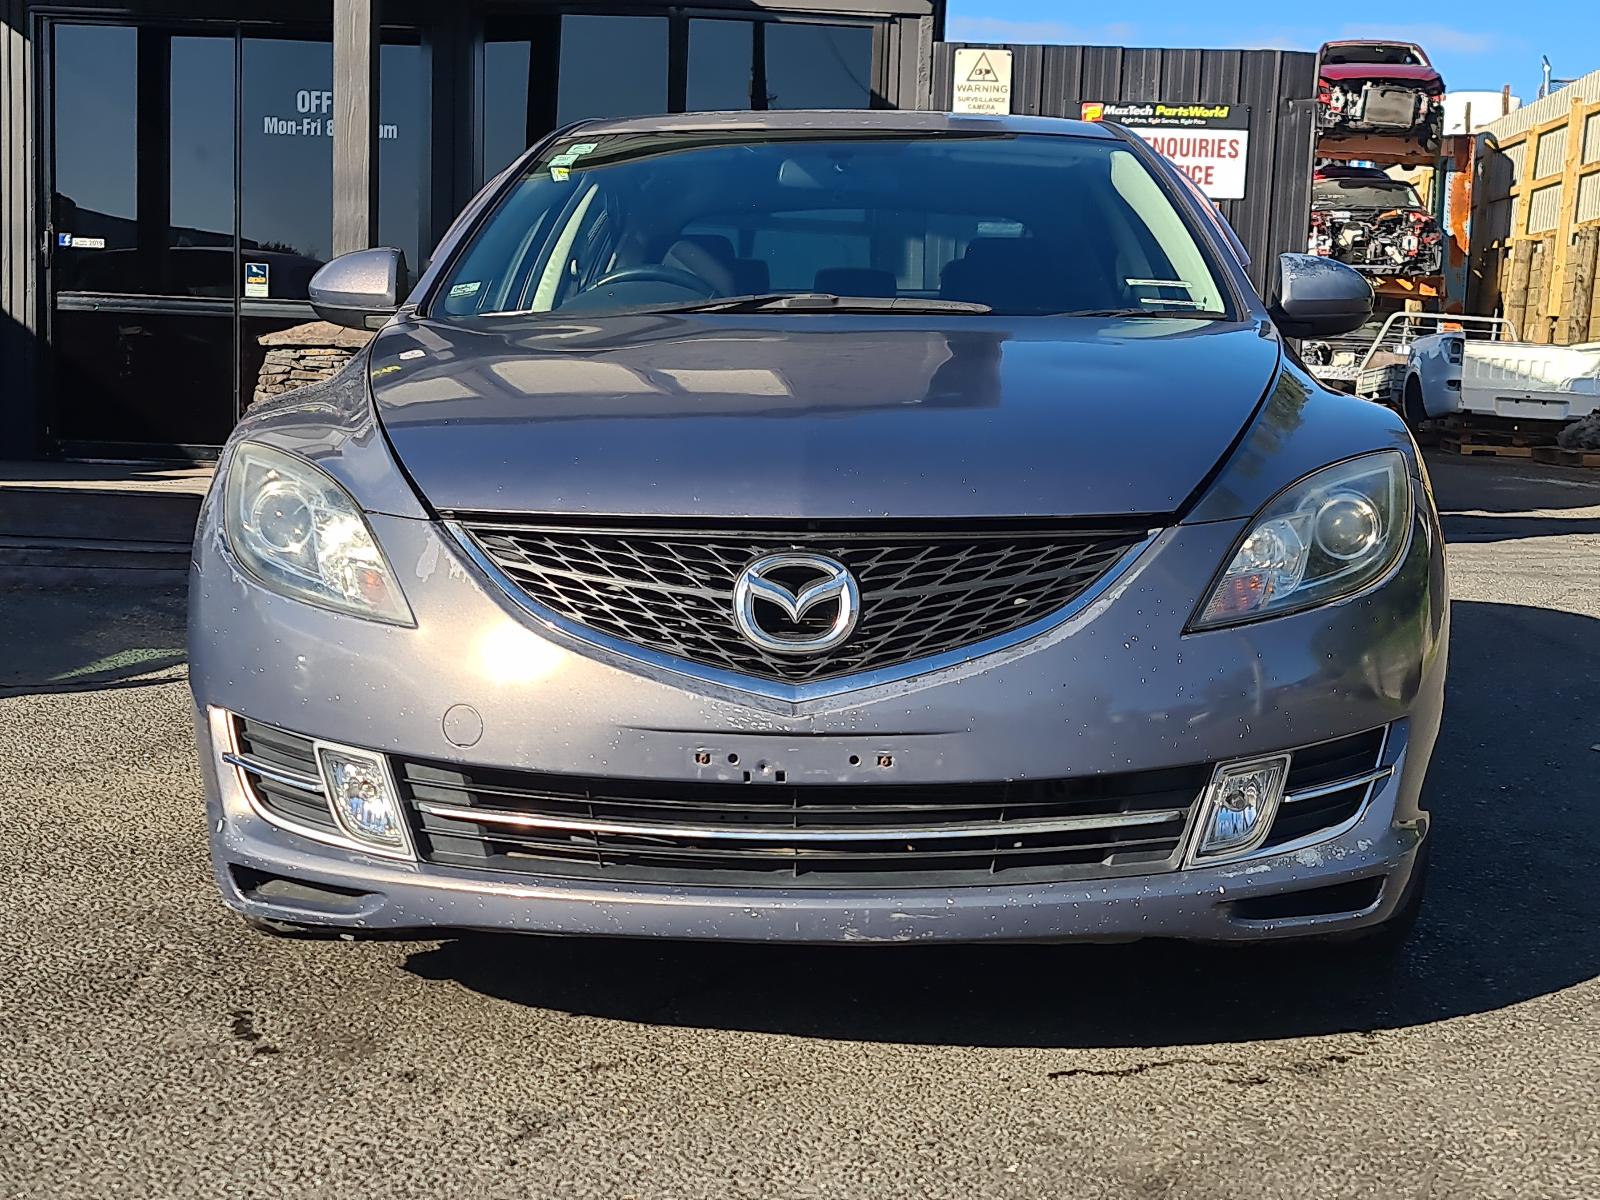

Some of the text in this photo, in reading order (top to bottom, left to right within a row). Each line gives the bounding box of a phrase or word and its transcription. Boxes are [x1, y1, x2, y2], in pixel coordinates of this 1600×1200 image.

[957, 85, 1008, 93] WARNING
[296, 90, 333, 113] OFF
[1104, 105, 1229, 118] MazTech PartsWorld
[264, 117, 321, 136] Mon-Fri
